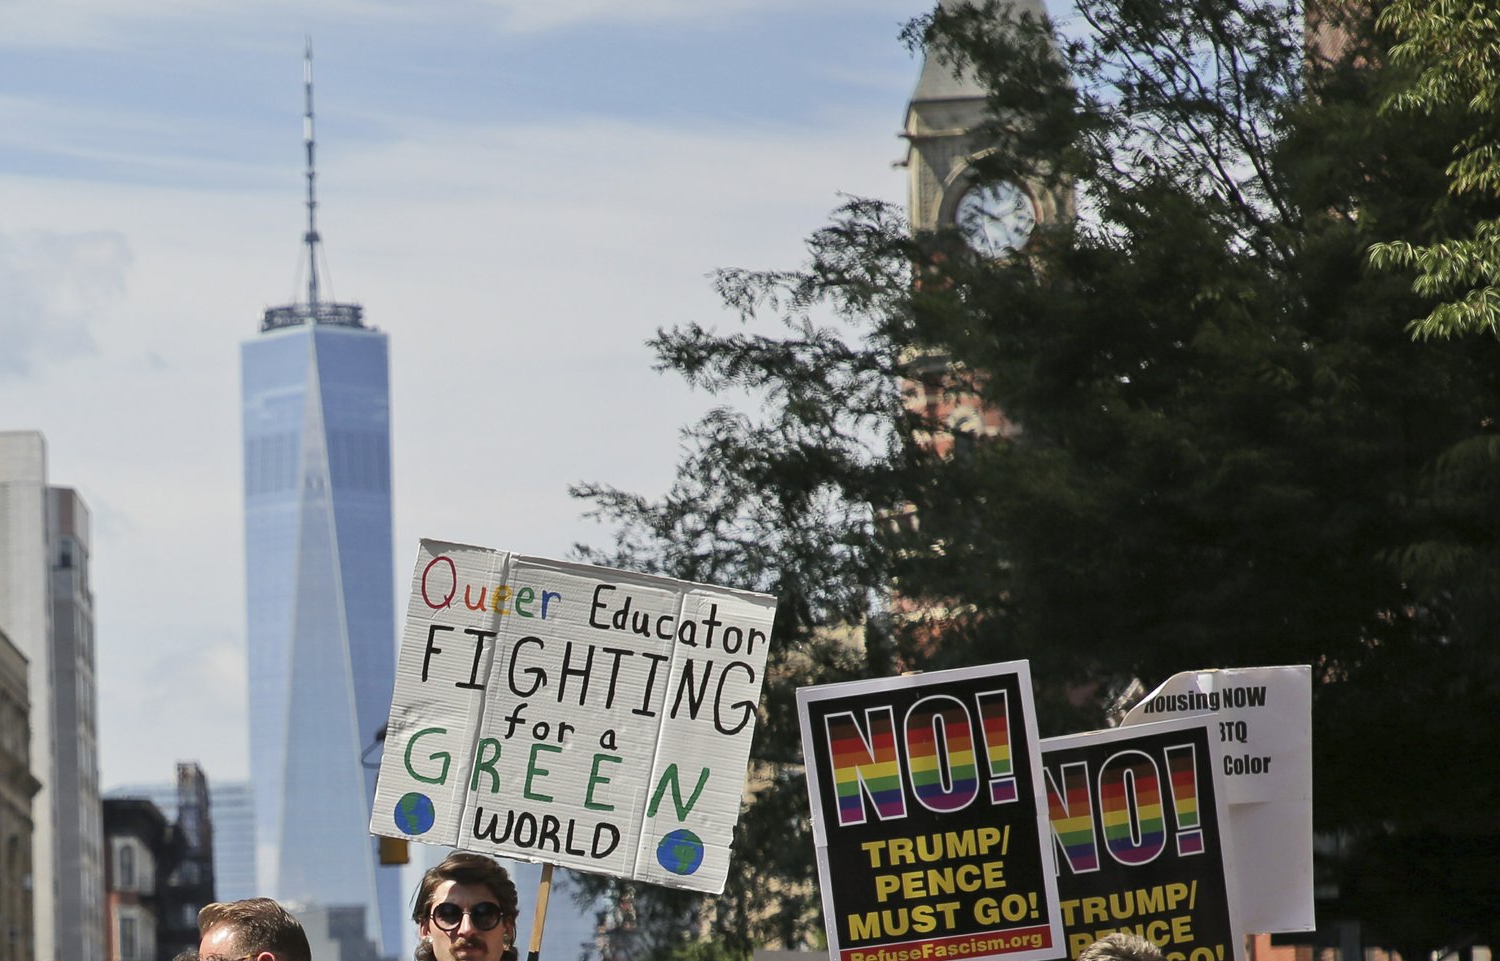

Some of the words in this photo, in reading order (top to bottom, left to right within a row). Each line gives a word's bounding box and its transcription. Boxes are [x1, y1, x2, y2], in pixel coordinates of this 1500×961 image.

[421, 556, 562, 619] Queer
[589, 584, 766, 654] Educator
[422, 624, 757, 735] FIGHTING
[1222, 686, 1267, 709] NOW
[504, 703, 575, 742] for
[599, 728, 618, 751] a
[404, 727, 710, 822] GREEN
[824, 689, 1019, 827] NO!
[1223, 754, 1272, 776] Color
[473, 806, 620, 859] WORLD
[1043, 743, 1205, 877] NO!
[861, 825, 1010, 868] TRUMP/
[875, 861, 1006, 902] PENCE
[1059, 880, 1197, 927] TRUMP/
[848, 901, 961, 941] MUST
[973, 892, 1039, 926] GO!
